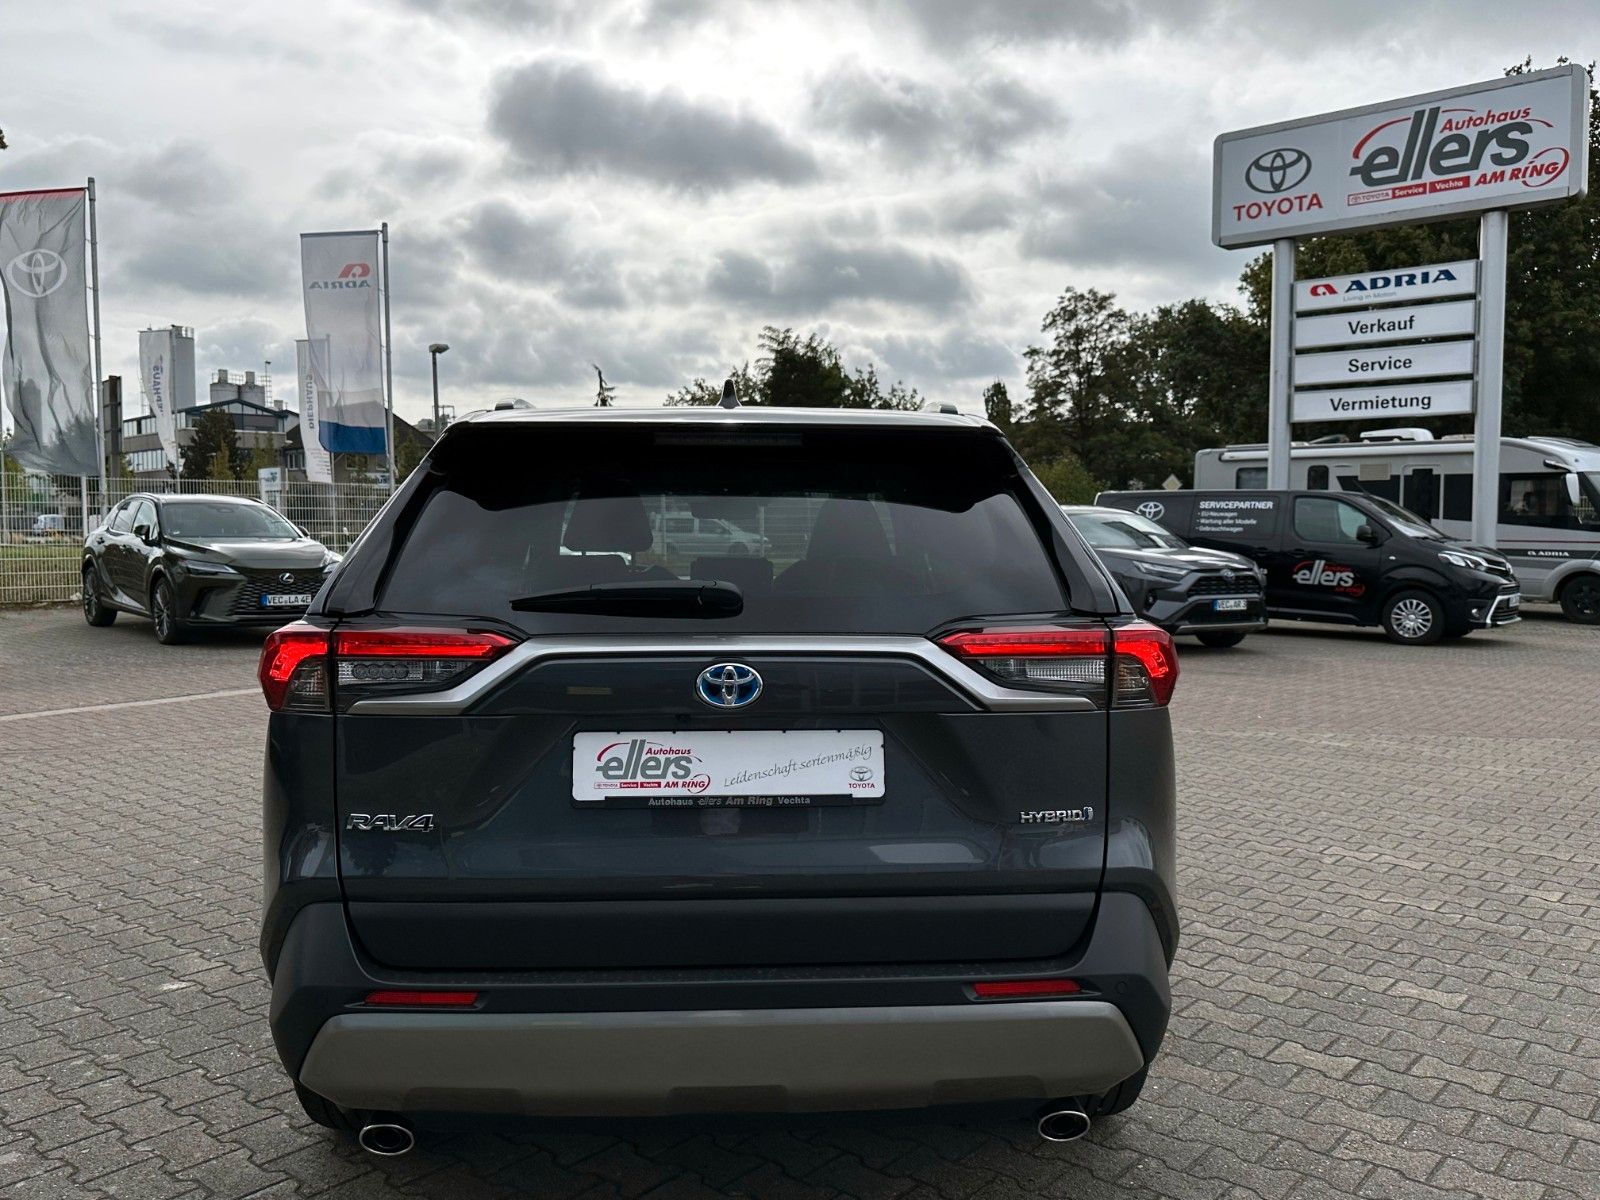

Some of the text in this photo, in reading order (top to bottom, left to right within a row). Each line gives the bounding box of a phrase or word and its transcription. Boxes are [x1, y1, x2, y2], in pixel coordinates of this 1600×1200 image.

[1440, 107, 1531, 133] Autohaus
[1349, 106, 1534, 187] ellers
[1475, 161, 1560, 187] AM RING
[1394, 187, 1424, 197] Service
[1435, 180, 1463, 190] Vechta
[1233, 193, 1323, 222] TOYOTA
[1345, 269, 1457, 293] ADRIA
[1348, 315, 1415, 335] Verkauf
[1348, 356, 1412, 373] Service
[1330, 396, 1432, 412] Vermietung
[1199, 501, 1274, 509] SERVICEPARTNER
[1292, 559, 1355, 587] ellers
[595, 739, 693, 780] ellers
[645, 747, 692, 756] Autohaus
[724, 744, 872, 788] Leidenschaft serienmäßig
[663, 780, 706, 789] AM RING
[648, 798, 693, 806] Autohaus
[725, 797, 744, 805] Am
[747, 796, 773, 806] Ring
[778, 797, 811, 805] Vechta
[346, 813, 434, 833] RAV4
[1020, 809, 1083, 823] HYBRID
